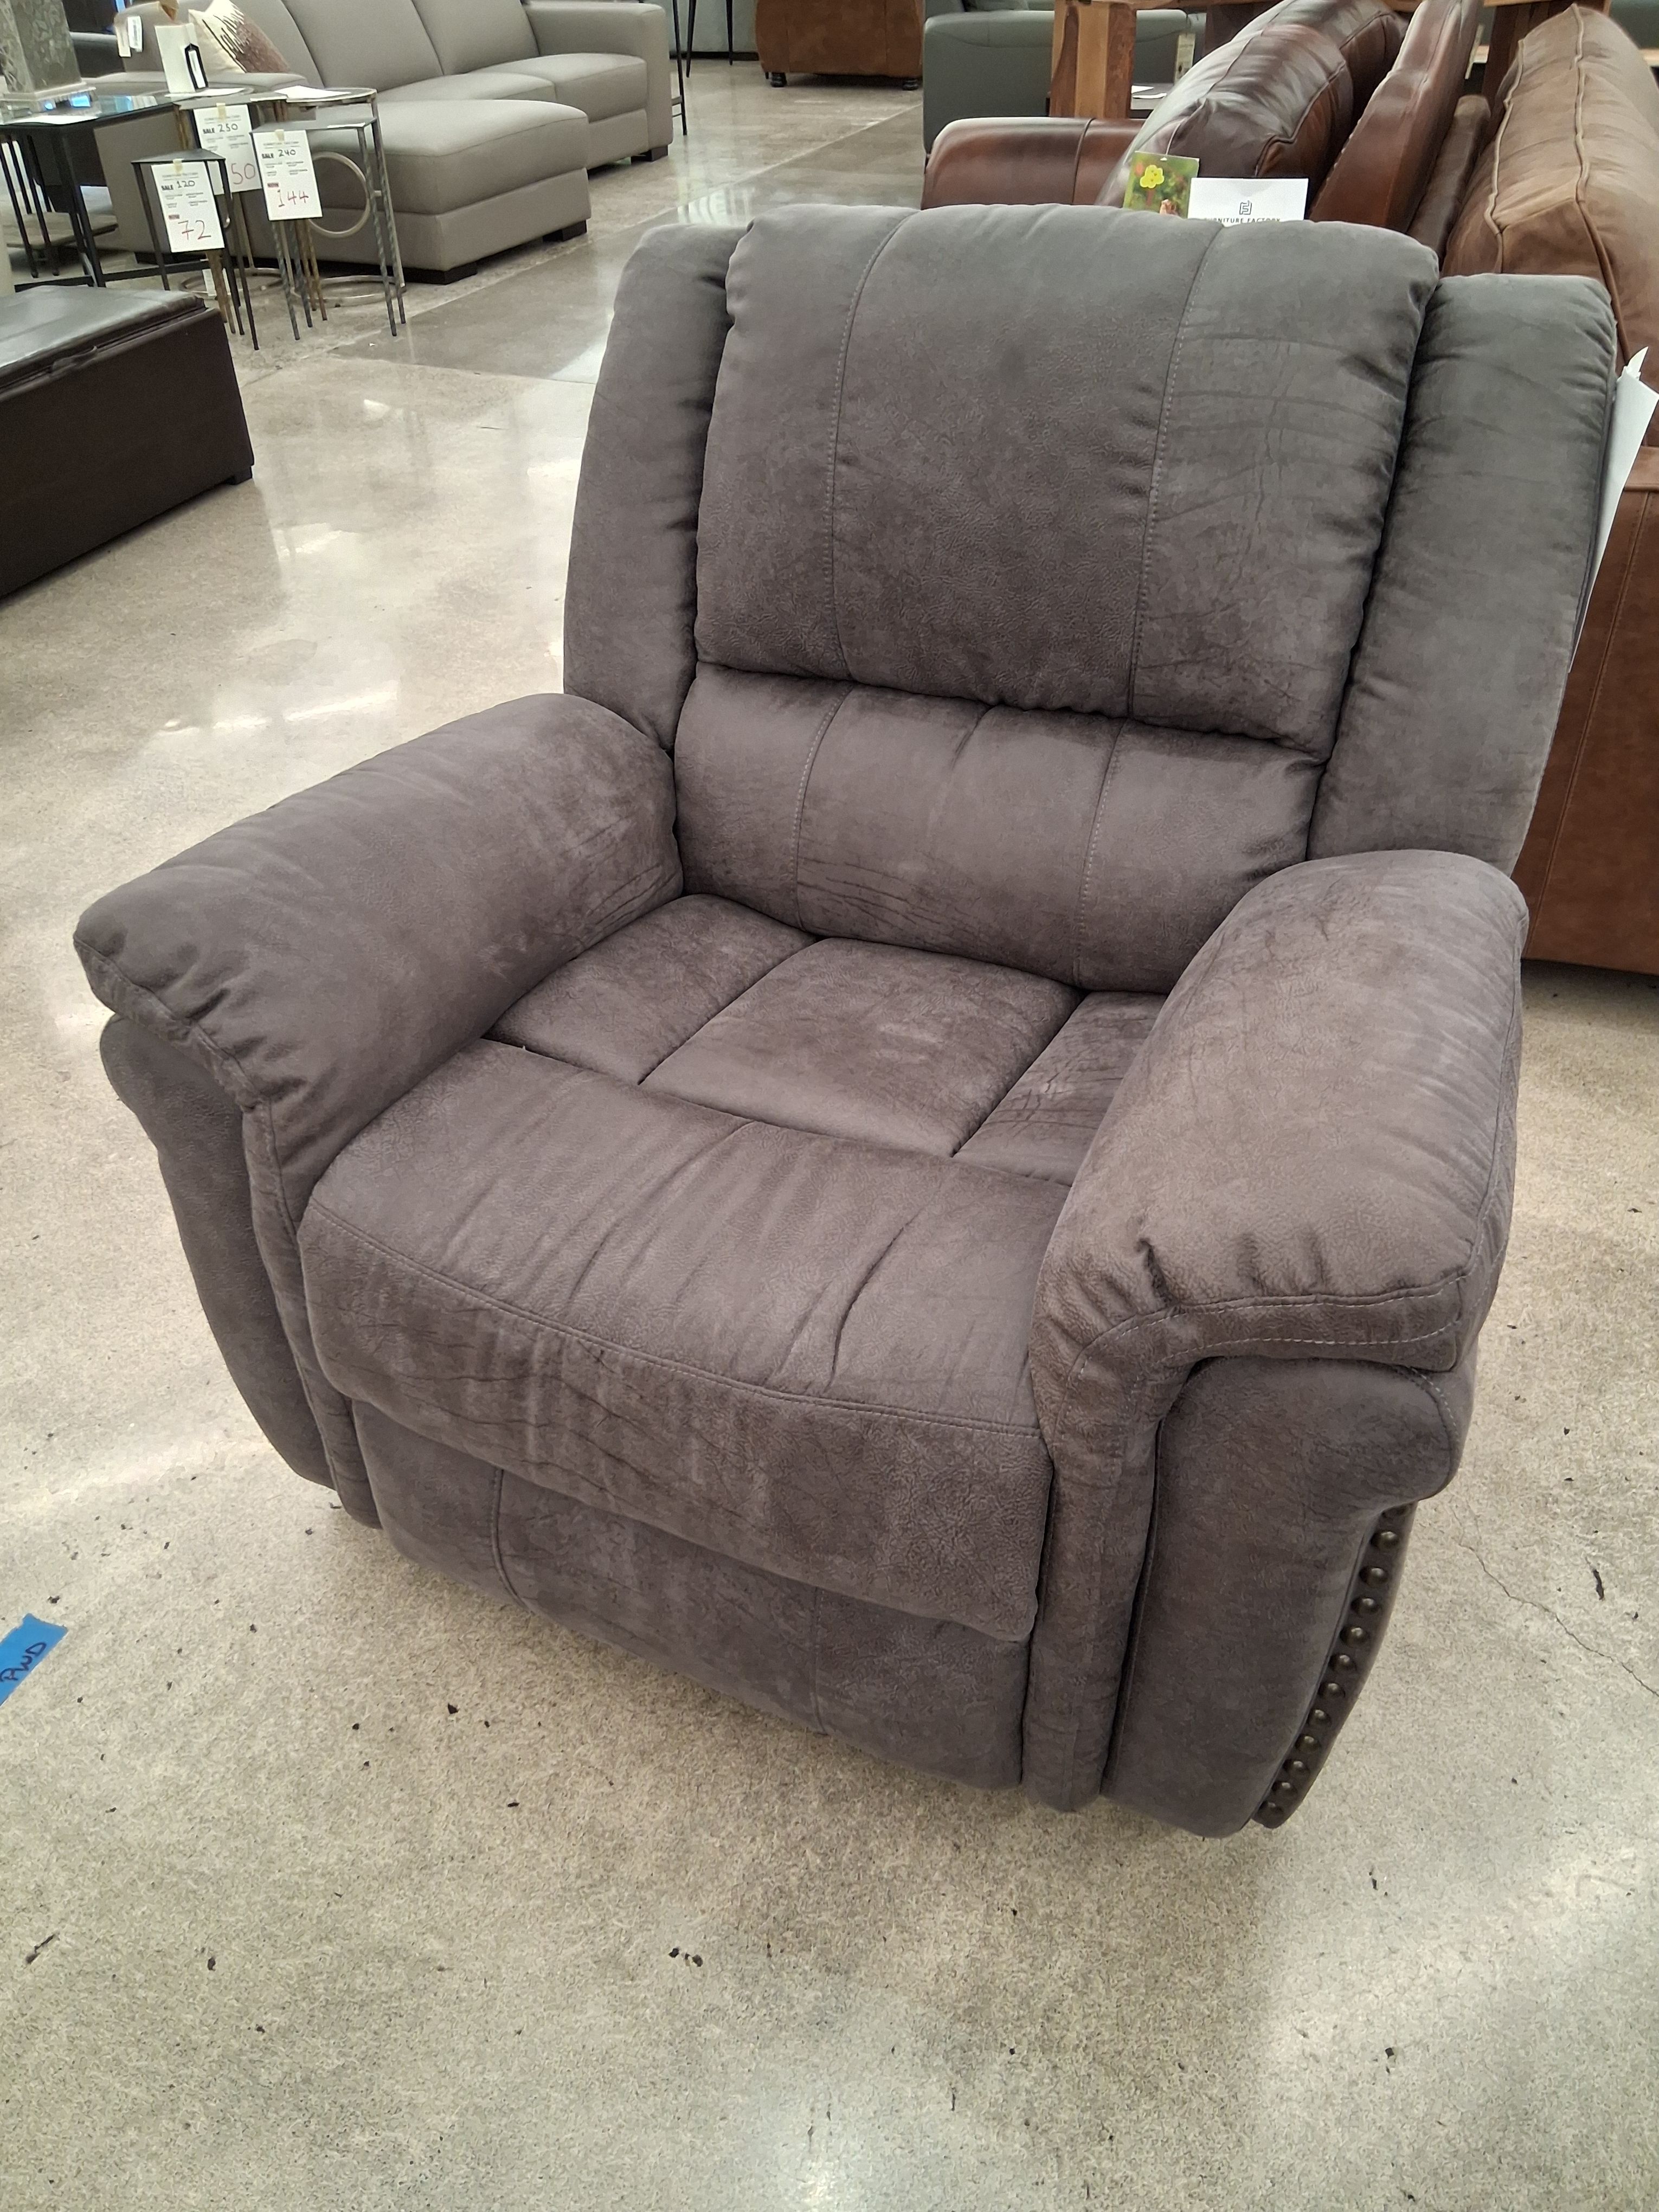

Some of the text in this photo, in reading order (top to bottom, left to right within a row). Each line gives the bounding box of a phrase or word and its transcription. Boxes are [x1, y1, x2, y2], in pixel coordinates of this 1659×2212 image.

[217, 124, 238, 132] 250
[278, 149, 296, 157] 240
[177, 180, 195, 188] 120
[277, 189, 309, 207] 144
[178, 220, 211, 240] 72
